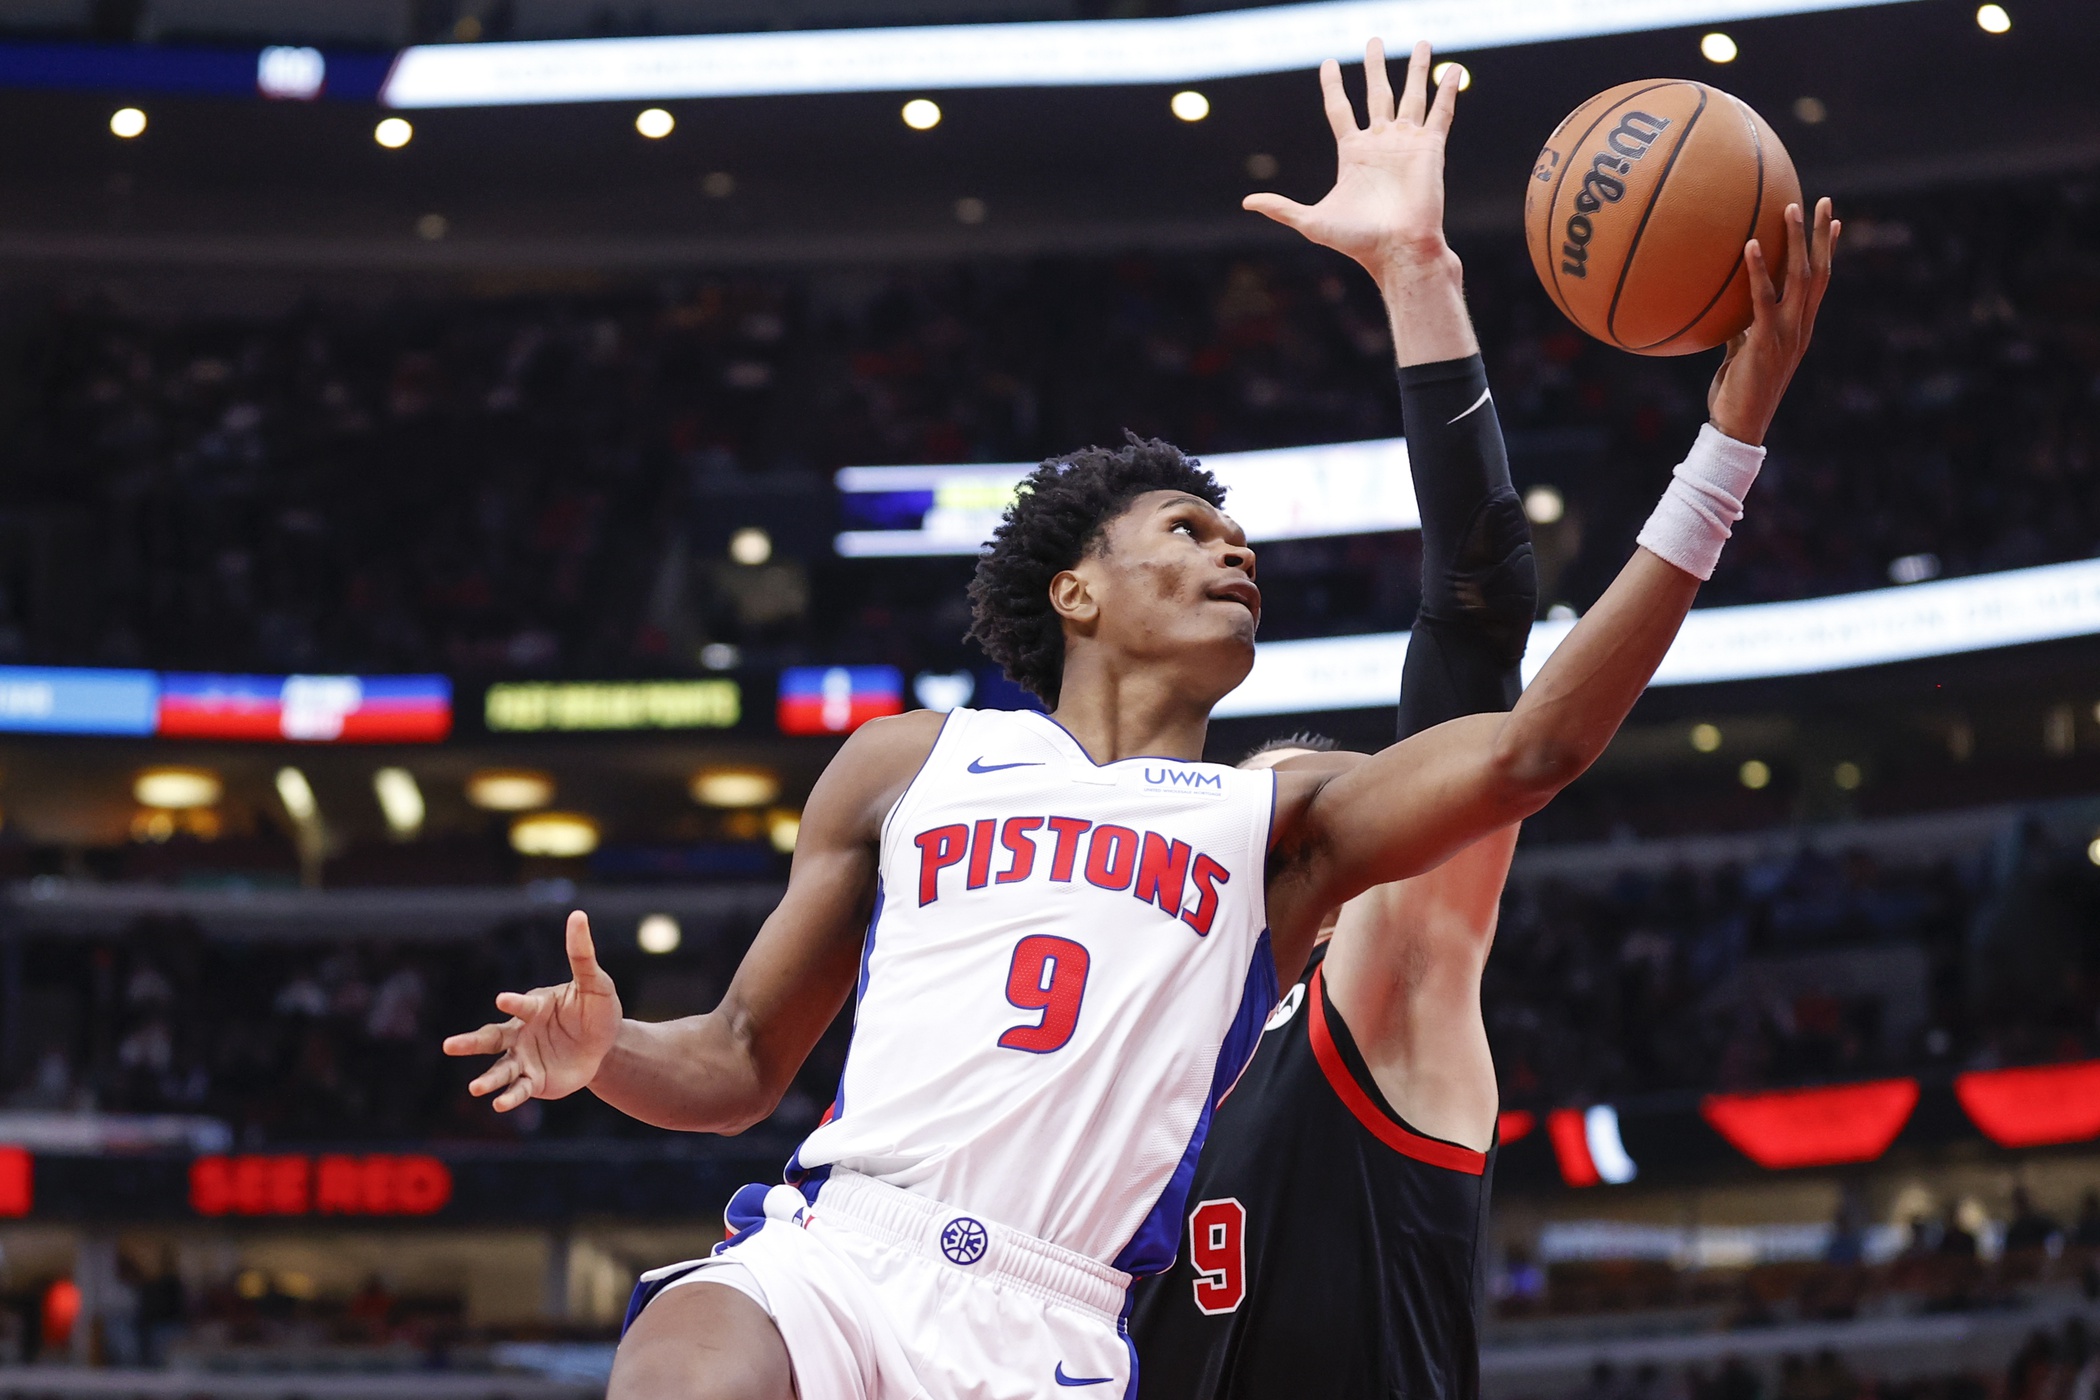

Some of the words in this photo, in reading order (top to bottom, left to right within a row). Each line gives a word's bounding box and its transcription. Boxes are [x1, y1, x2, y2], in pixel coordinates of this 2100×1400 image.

[1561, 110, 1674, 280] Wilson
[1144, 768, 1221, 789] UWM
[914, 815, 1230, 937] PISTONS
[997, 933, 1090, 1054] 9
[1189, 1197, 1246, 1315] 9
